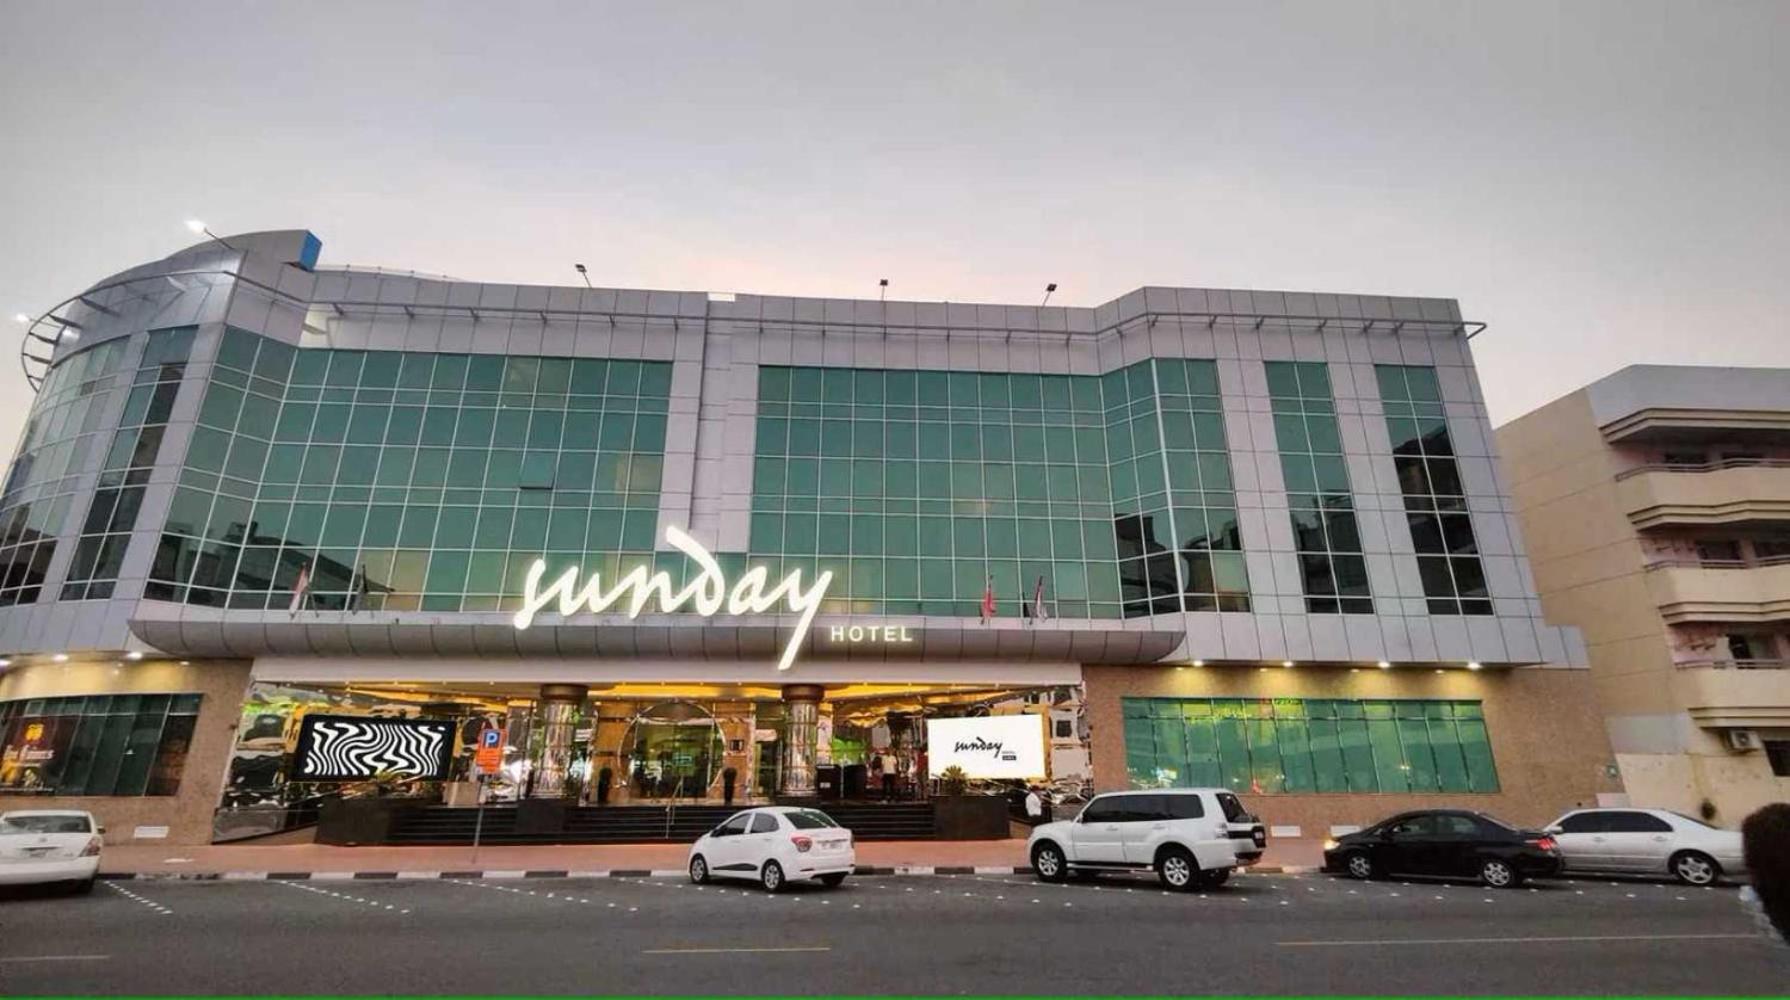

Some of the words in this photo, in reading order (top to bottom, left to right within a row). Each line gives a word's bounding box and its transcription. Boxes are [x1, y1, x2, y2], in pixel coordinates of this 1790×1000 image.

[513, 525, 833, 670] sunday
[831, 625, 913, 642] HOTEL
[485, 732, 498, 748] P
[954, 736, 1003, 759] sunday
